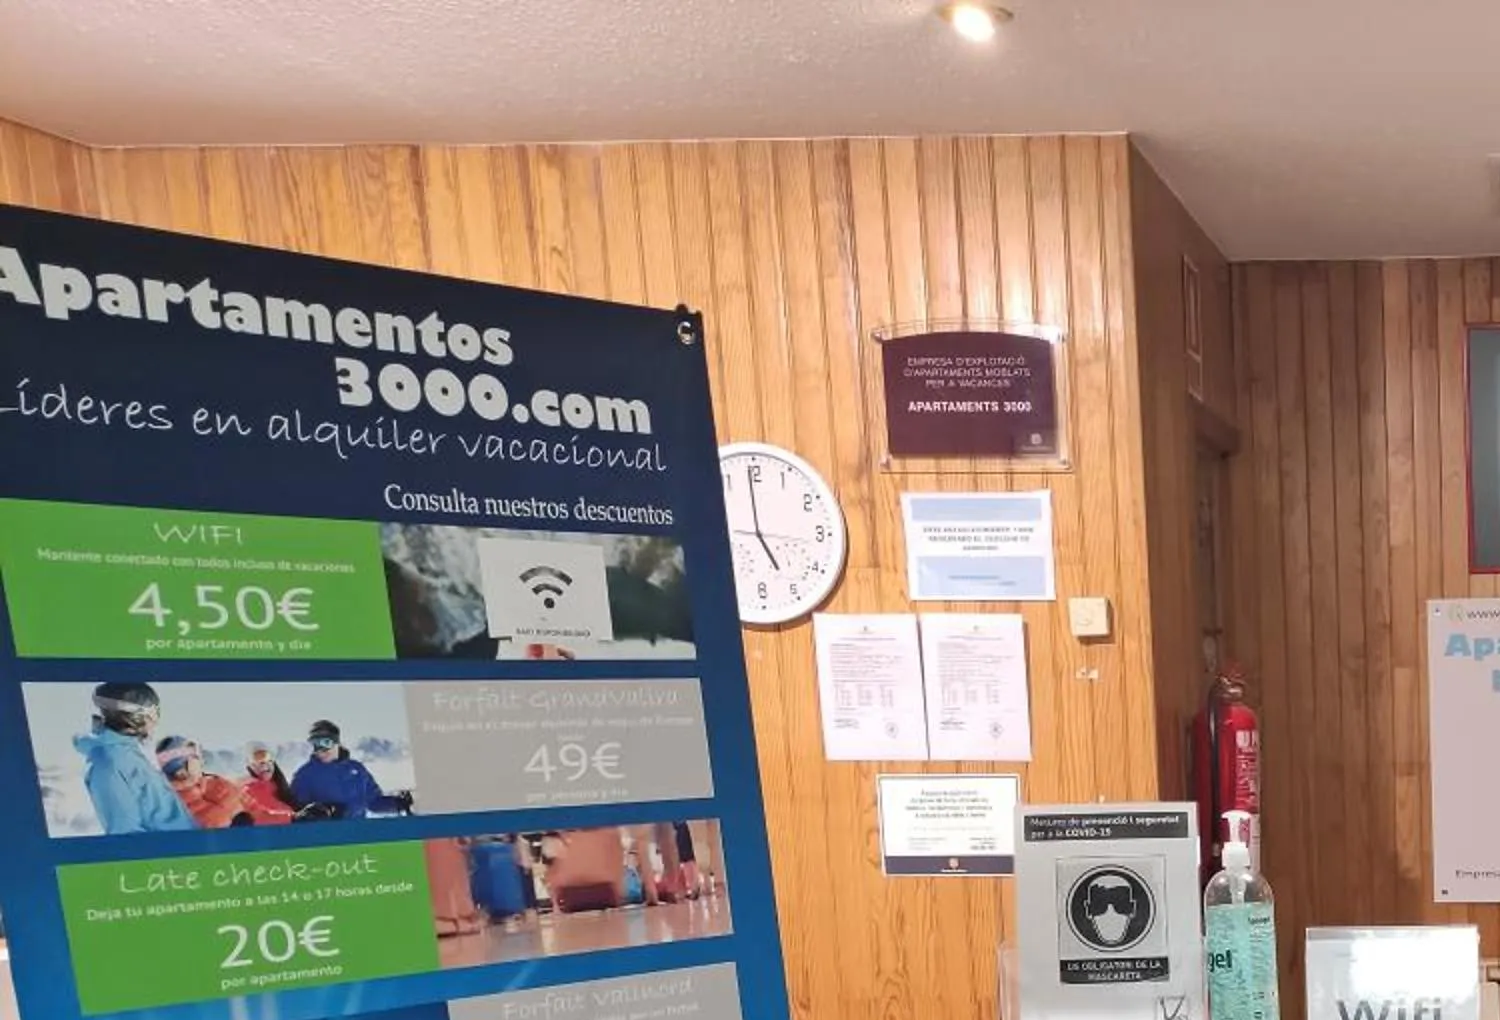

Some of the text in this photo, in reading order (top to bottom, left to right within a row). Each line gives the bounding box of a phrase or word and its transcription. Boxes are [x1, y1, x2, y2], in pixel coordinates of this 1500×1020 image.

[0, 245, 514, 366] Apartamentos
[907, 357, 953, 367] EMPRESA
[334, 357, 652, 434] 3000.com
[925, 379, 945, 388] PER
[907, 401, 1033, 412] APARTAMENTS 3000
[192, 405, 252, 436] en
[267, 410, 447, 461] alquiler
[458, 429, 668, 472] vacacional
[383, 483, 675, 526] Consulta nuestros descuentos
[803, 493, 813, 512] 2
[152, 521, 244, 546] WIFI
[815, 525, 825, 543] 3
[789, 583, 798, 595] 5
[128, 582, 320, 636] 4,50€
[145, 638, 173, 651] por
[177, 638, 274, 652] apartamento
[523, 741, 627, 783] 49€
[1065, 826, 1113, 838] COVID-19
[118, 853, 379, 893] Late check-out
[87, 908, 123, 922] Deja
[126, 905, 142, 918] tu
[146, 895, 241, 916] apartamento
[281, 891, 300, 904] 14
[315, 888, 332, 901] 17
[335, 884, 373, 898] horas
[375, 880, 413, 895] desde
[217, 915, 341, 969] 20€
[221, 964, 342, 990] por apartamento
